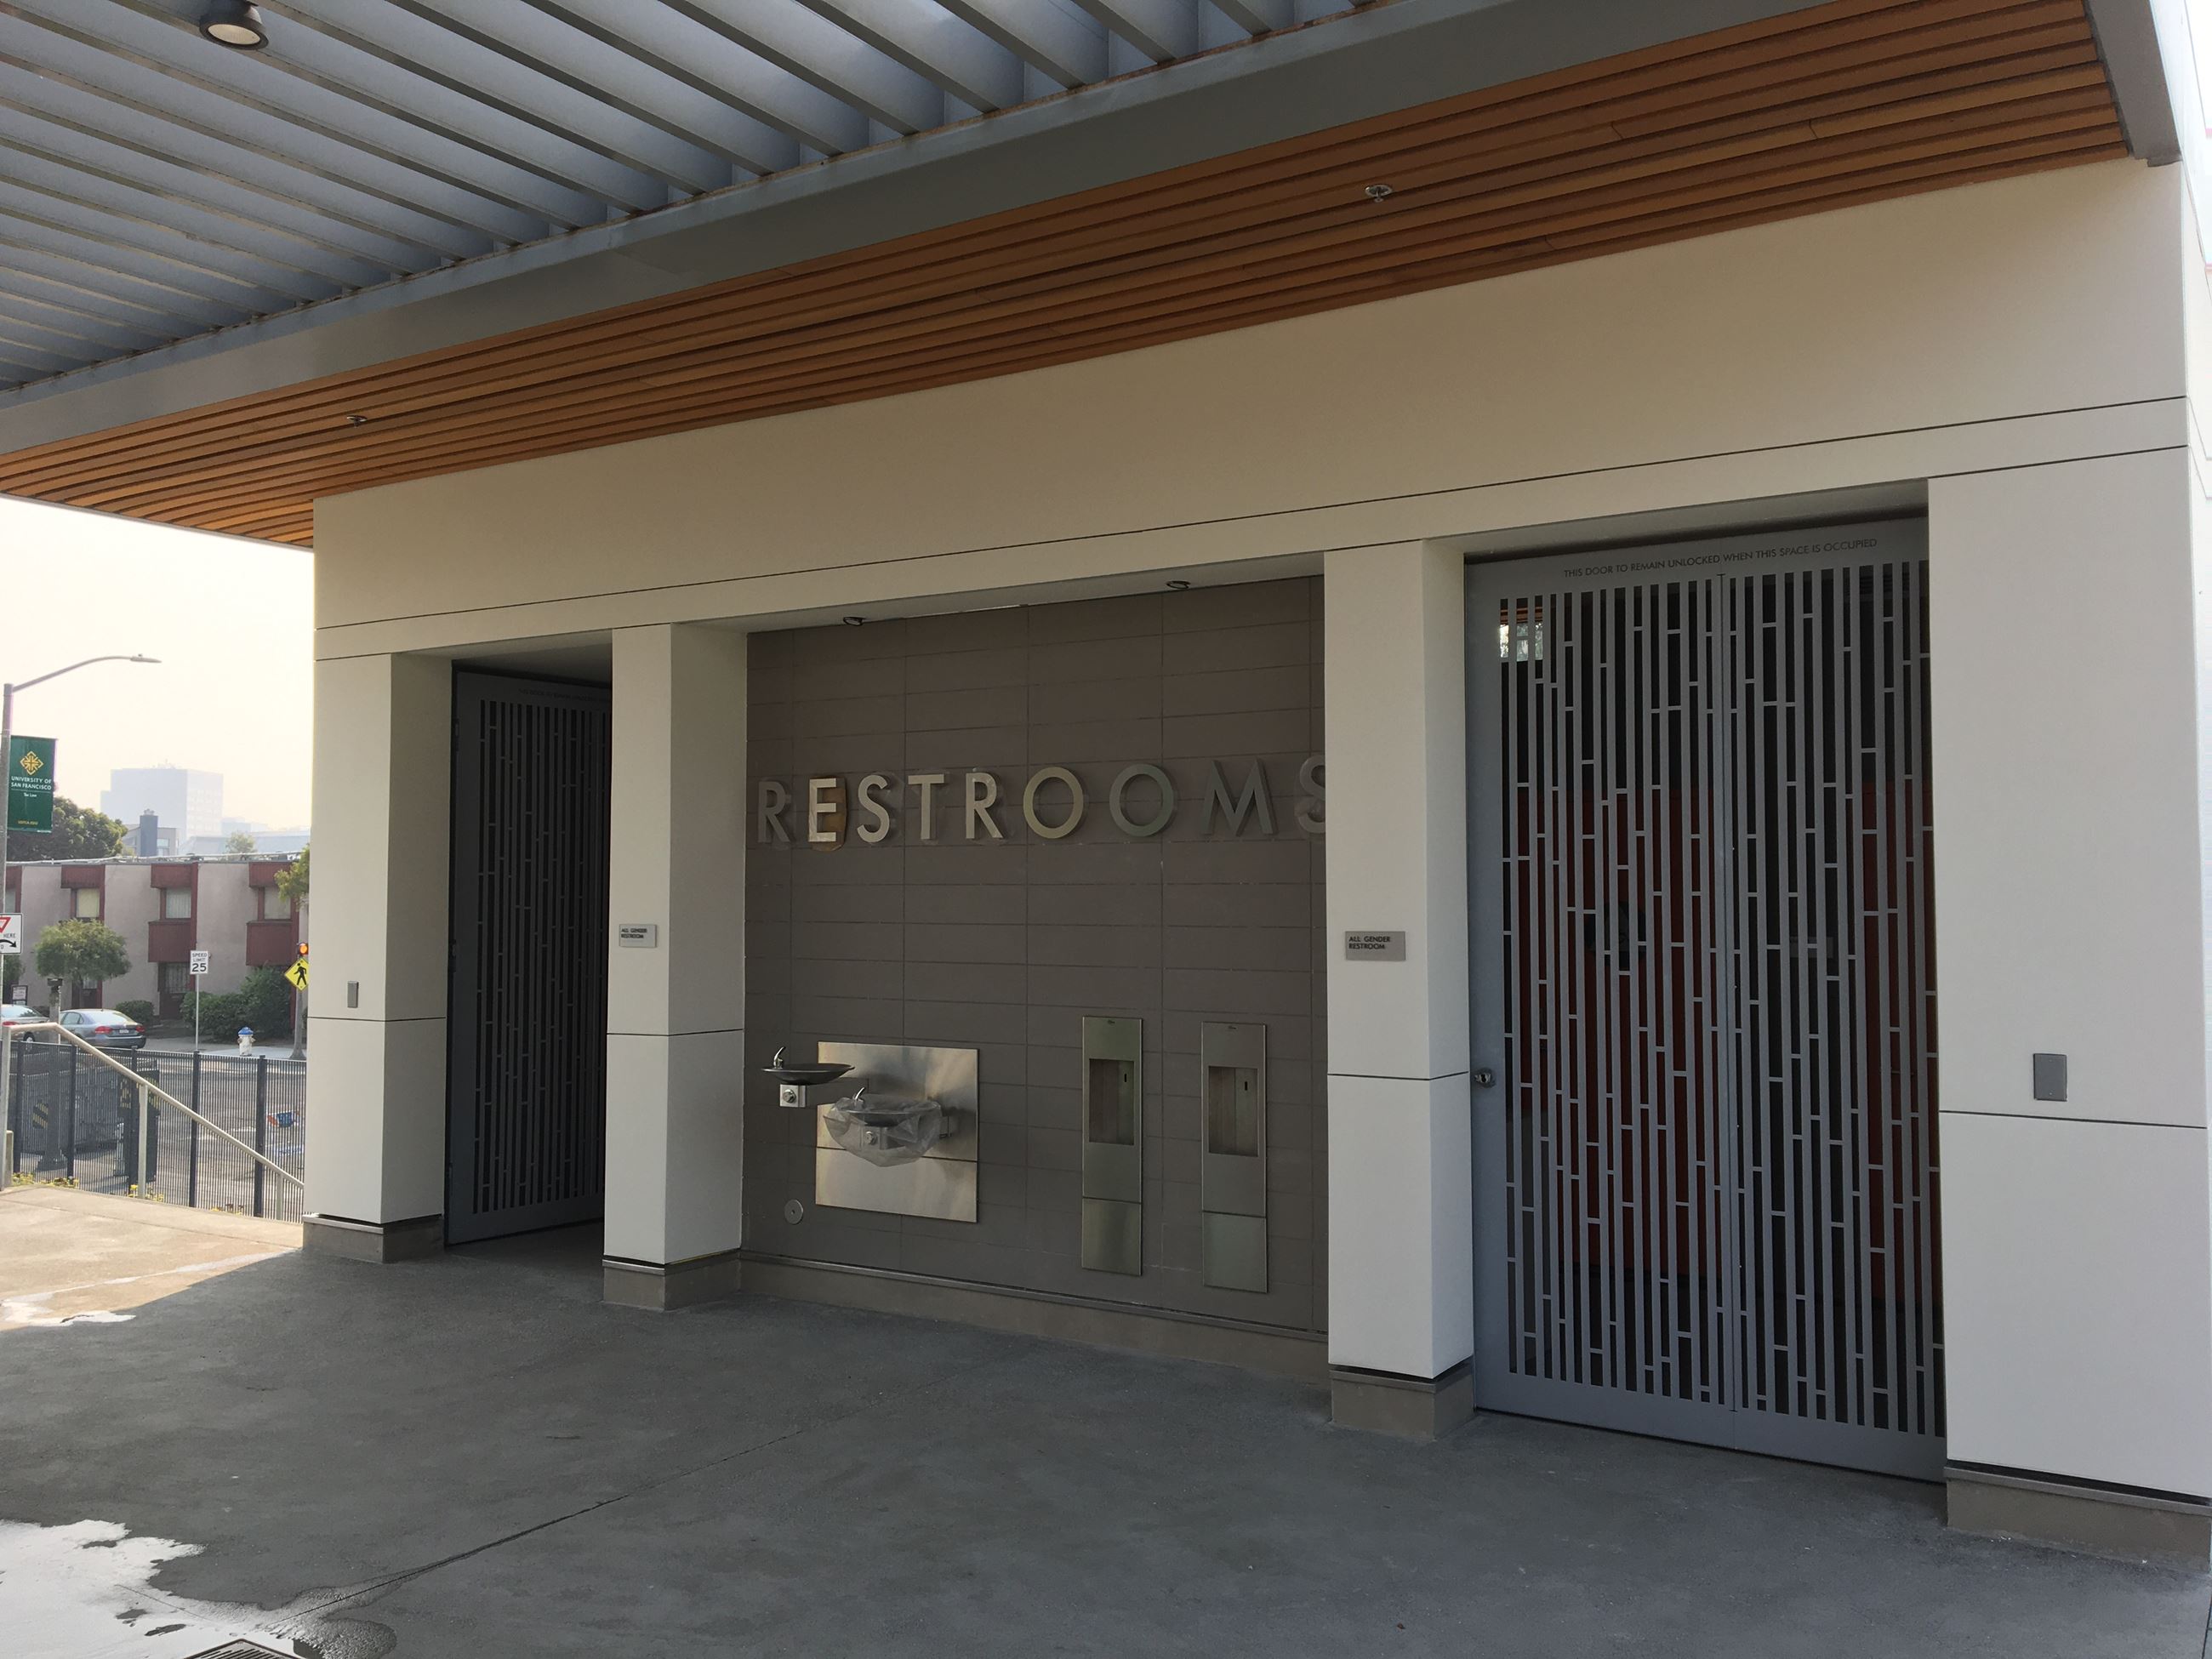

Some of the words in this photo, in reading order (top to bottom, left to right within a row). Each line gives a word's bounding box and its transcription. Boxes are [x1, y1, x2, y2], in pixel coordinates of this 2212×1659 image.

[1564, 568, 1582, 578] THIS
[1585, 565, 1614, 576] DOOR
[1616, 564, 1628, 573] TO
[1631, 561, 1665, 572] REMAIN
[1668, 555, 1720, 568] UNLOCKED
[1723, 551, 1753, 562] WHEN
[1755, 549, 1777, 558] THIS
[1780, 545, 1810, 557] SPACE
[1812, 544, 1821, 553] IS
[1823, 539, 1877, 552] OCCUPIED
[757, 755, 1326, 844] RESTROOMS
[192, 963, 207, 972] 25
